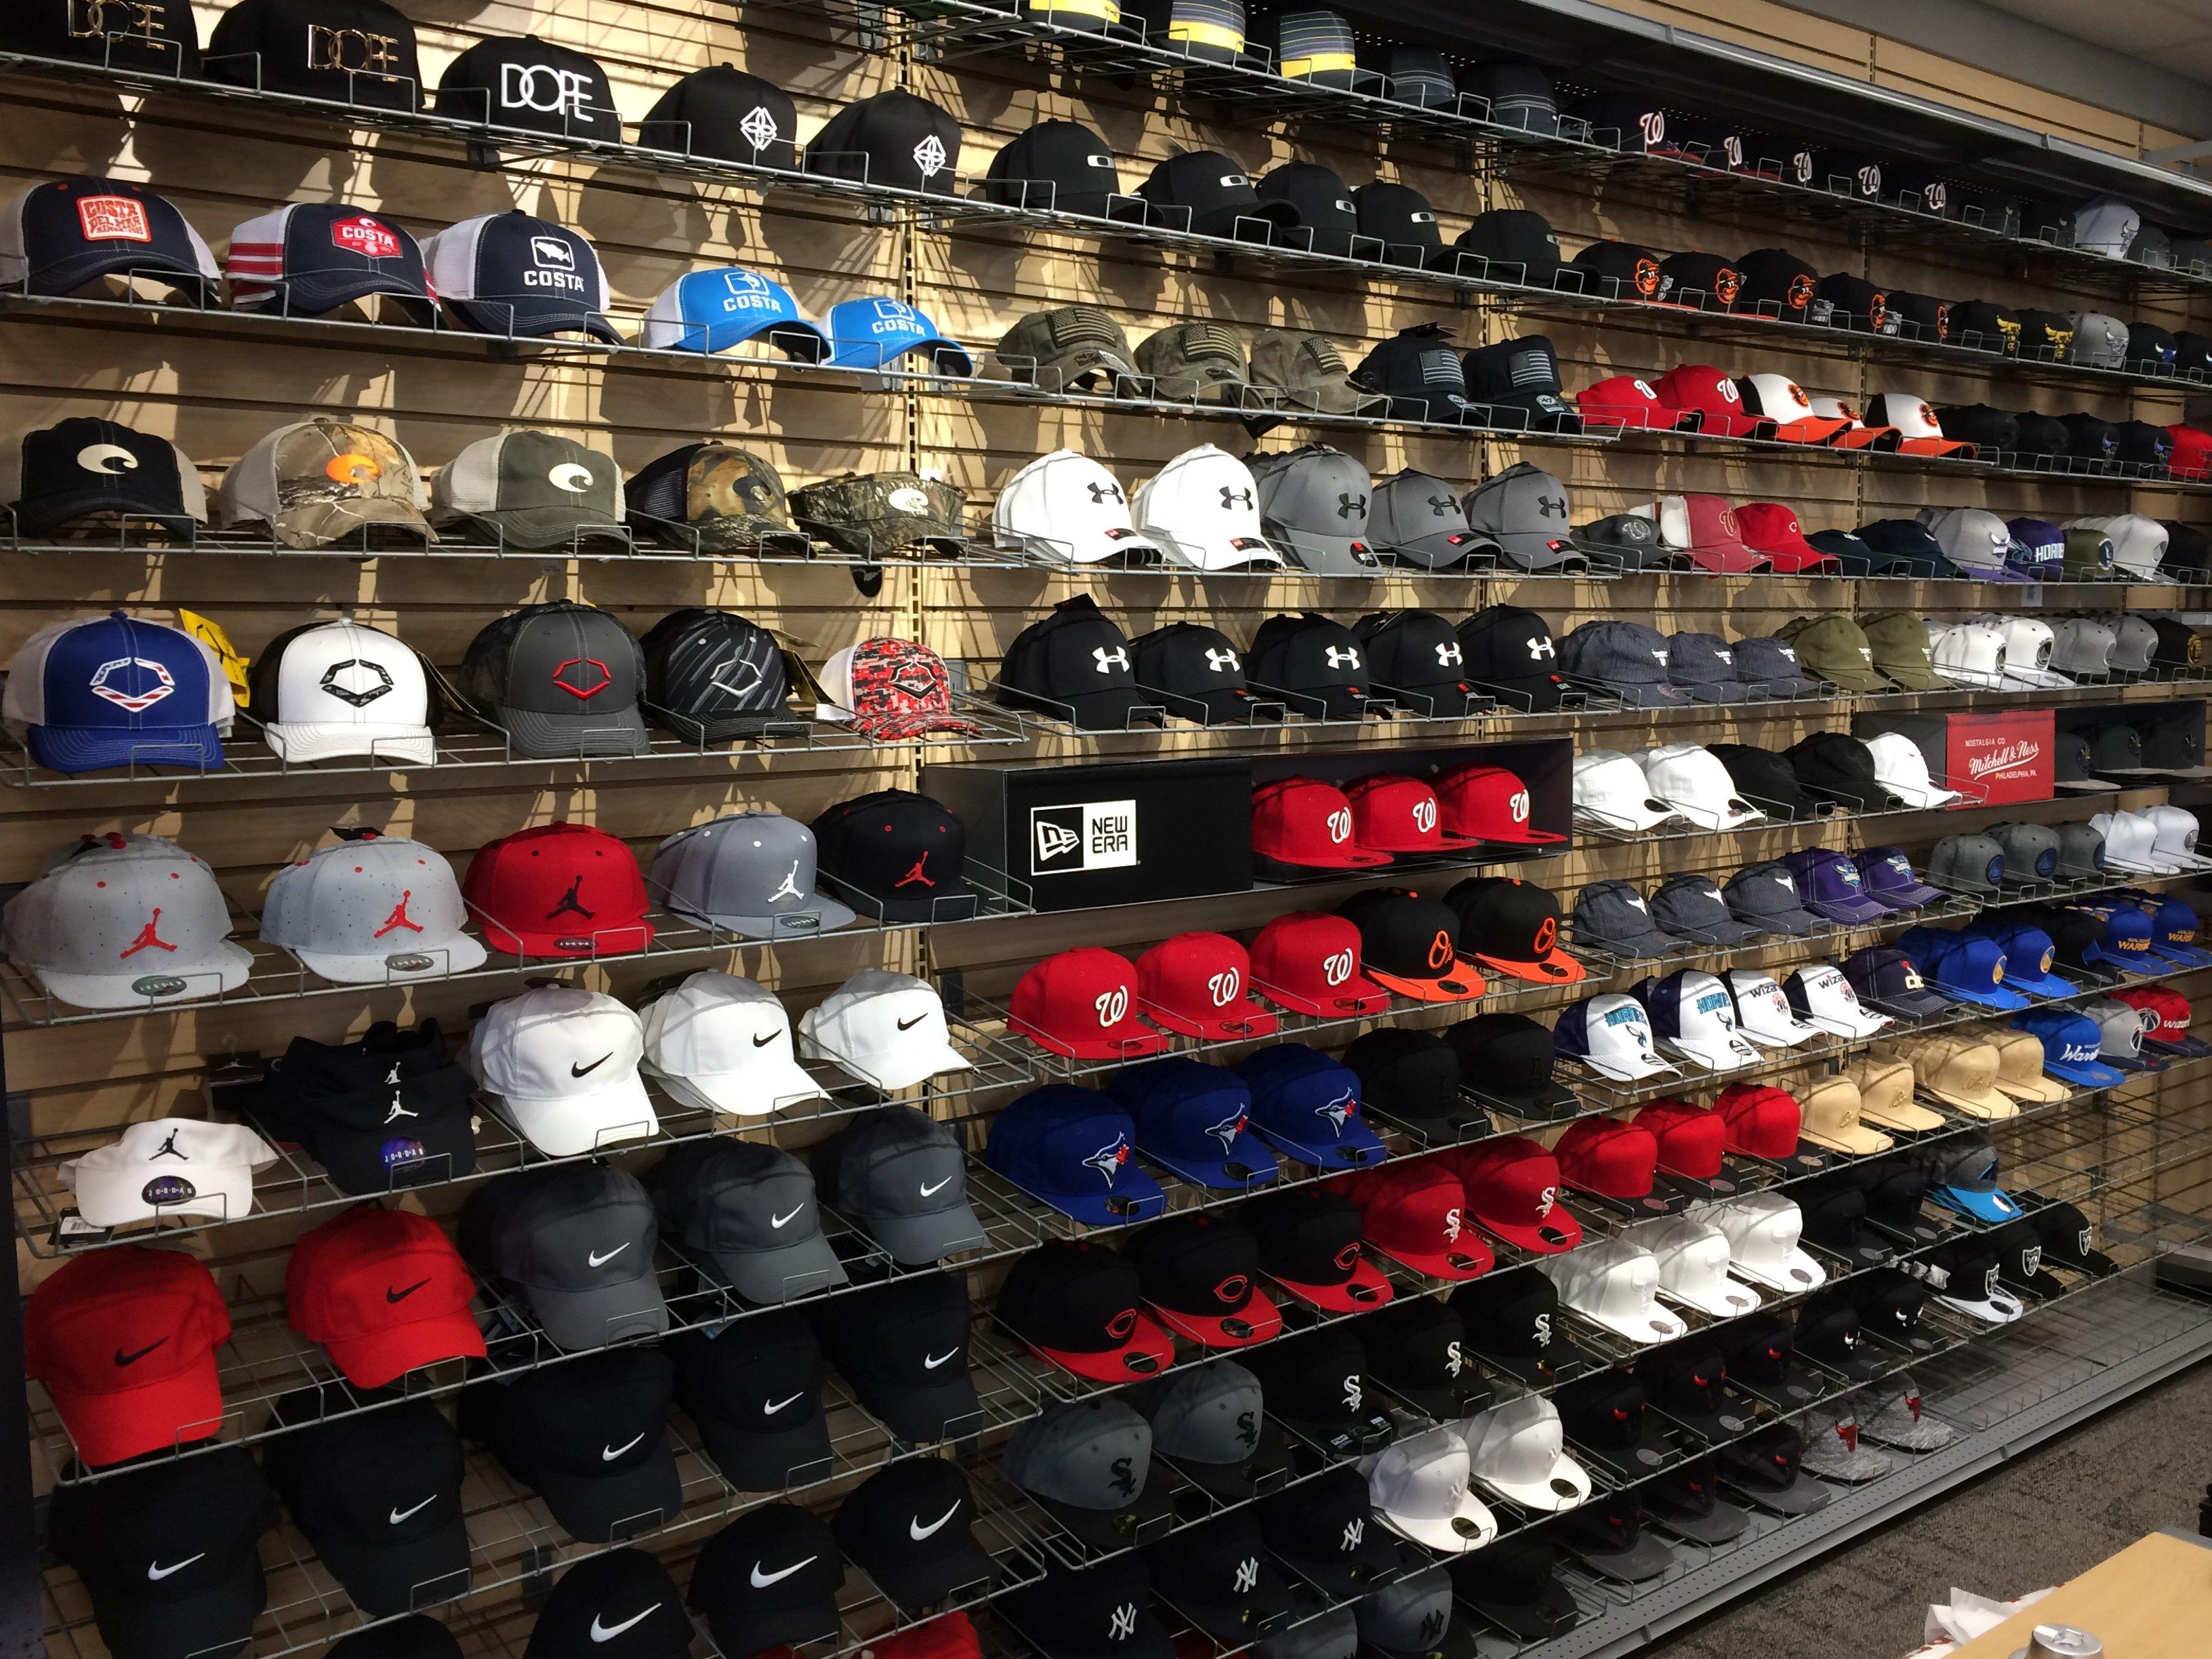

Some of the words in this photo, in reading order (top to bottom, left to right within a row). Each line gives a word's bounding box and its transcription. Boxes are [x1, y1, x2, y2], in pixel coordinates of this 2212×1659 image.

[308, 24, 398, 83] DOPE
[501, 63, 594, 122] DOPE
[83, 201, 139, 218] COSTA
[342, 227, 394, 248] COSTA
[524, 270, 584, 292] COSTA
[723, 295, 782, 313] COSTA
[872, 321, 926, 337] COSTA
[1965, 738, 1995, 747] NOSTALGIA
[1969, 749, 2009, 775] Mitchell
[2009, 746, 2016, 760] &
[2016, 741, 2039, 758] Ness
[1092, 816, 1128, 835] NEW
[1092, 834, 1128, 854] ERA
[1324, 947, 1353, 986] W
[1208, 966, 1240, 1007] W
[1095, 985, 1128, 1027] W
[384, 1148, 424, 1163] JORDAN
[148, 1187, 192, 1197] JORDAN
